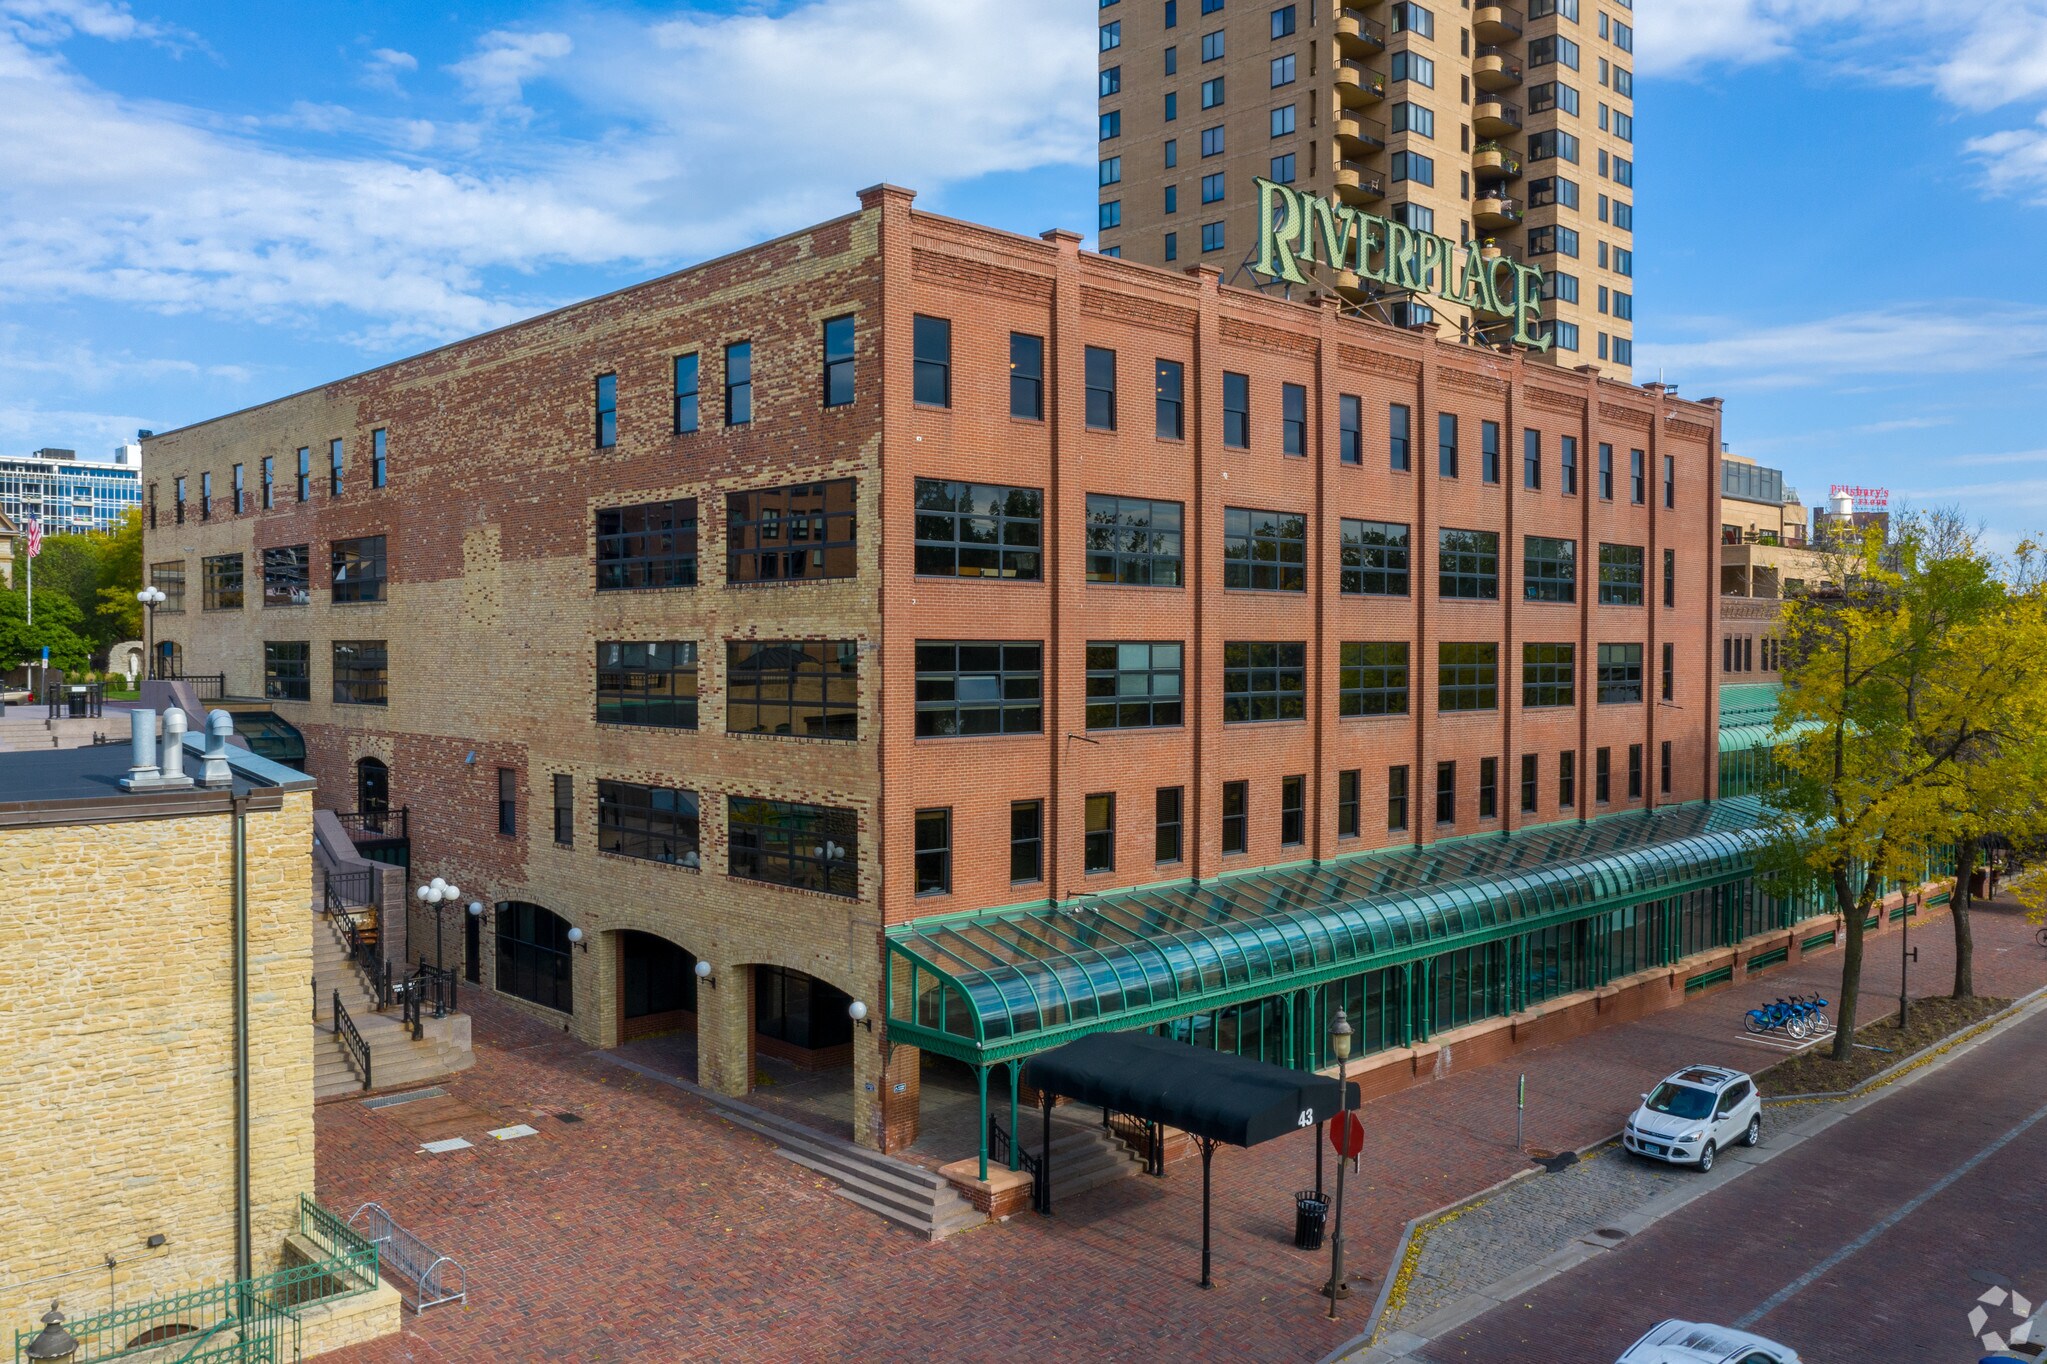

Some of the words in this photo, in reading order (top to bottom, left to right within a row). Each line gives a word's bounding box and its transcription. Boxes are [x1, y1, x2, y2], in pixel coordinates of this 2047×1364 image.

[1252, 176, 1553, 353] RIVERPLACE
[1831, 485, 1889, 498] Pillsbury's
[1298, 1108, 1314, 1127] 43
